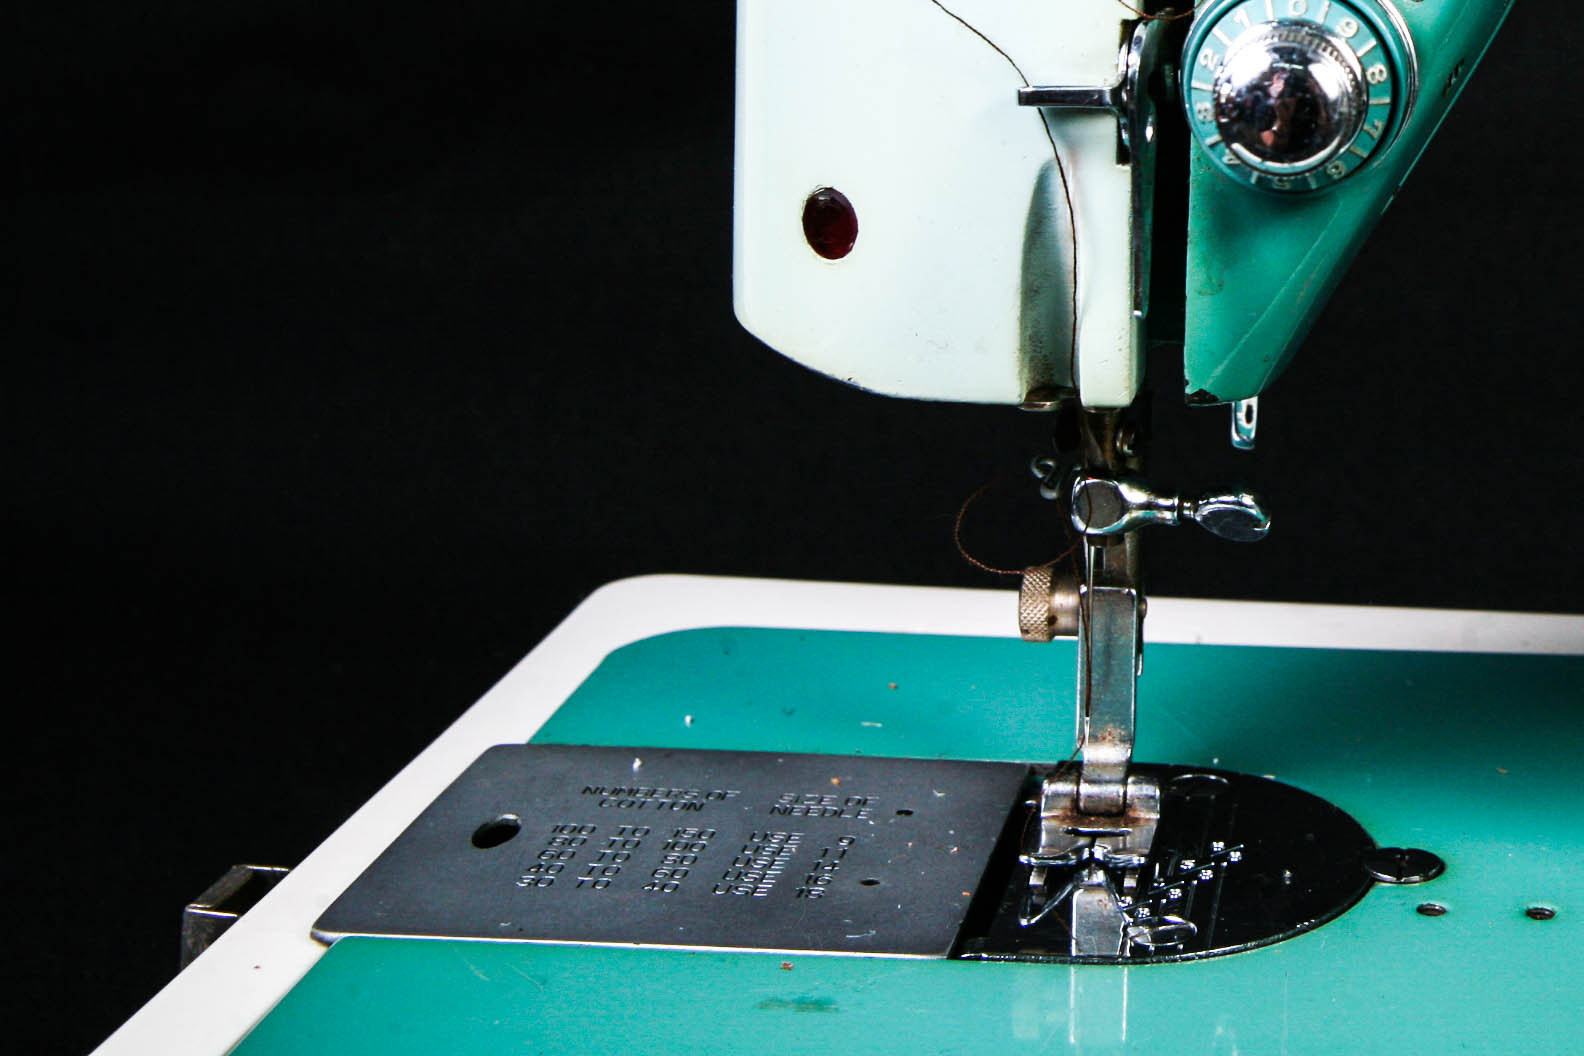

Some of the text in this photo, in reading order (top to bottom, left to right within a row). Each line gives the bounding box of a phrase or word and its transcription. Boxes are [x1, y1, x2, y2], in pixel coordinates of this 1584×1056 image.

[1336, 17, 1359, 39] 9
[1200, 47, 1220, 71] 2
[1366, 63, 1387, 85] 8
[582, 786, 741, 801] NUMBERS OF
[778, 793, 880, 807] SIZE OF
[599, 798, 705, 811] COTTON
[769, 804, 873, 819] NEEDLE
[552, 823, 597, 835] 100
[616, 825, 650, 837] TO
[673, 827, 716, 840] 150
[750, 831, 804, 843] USE
[607, 837, 641, 849] TO
[662, 839, 707, 852] 100
[741, 843, 797, 857] USE
[537, 848, 576, 860] 60
[597, 849, 631, 862] TO
[732, 855, 790, 870] USE
[813, 859, 840, 872] 14
[526, 862, 834, 886] 40 TO 60 USE 16
[515, 875, 555, 888] 30
[575, 876, 612, 889] TO
[641, 880, 680, 893] 40
[712, 883, 773, 897] USE
